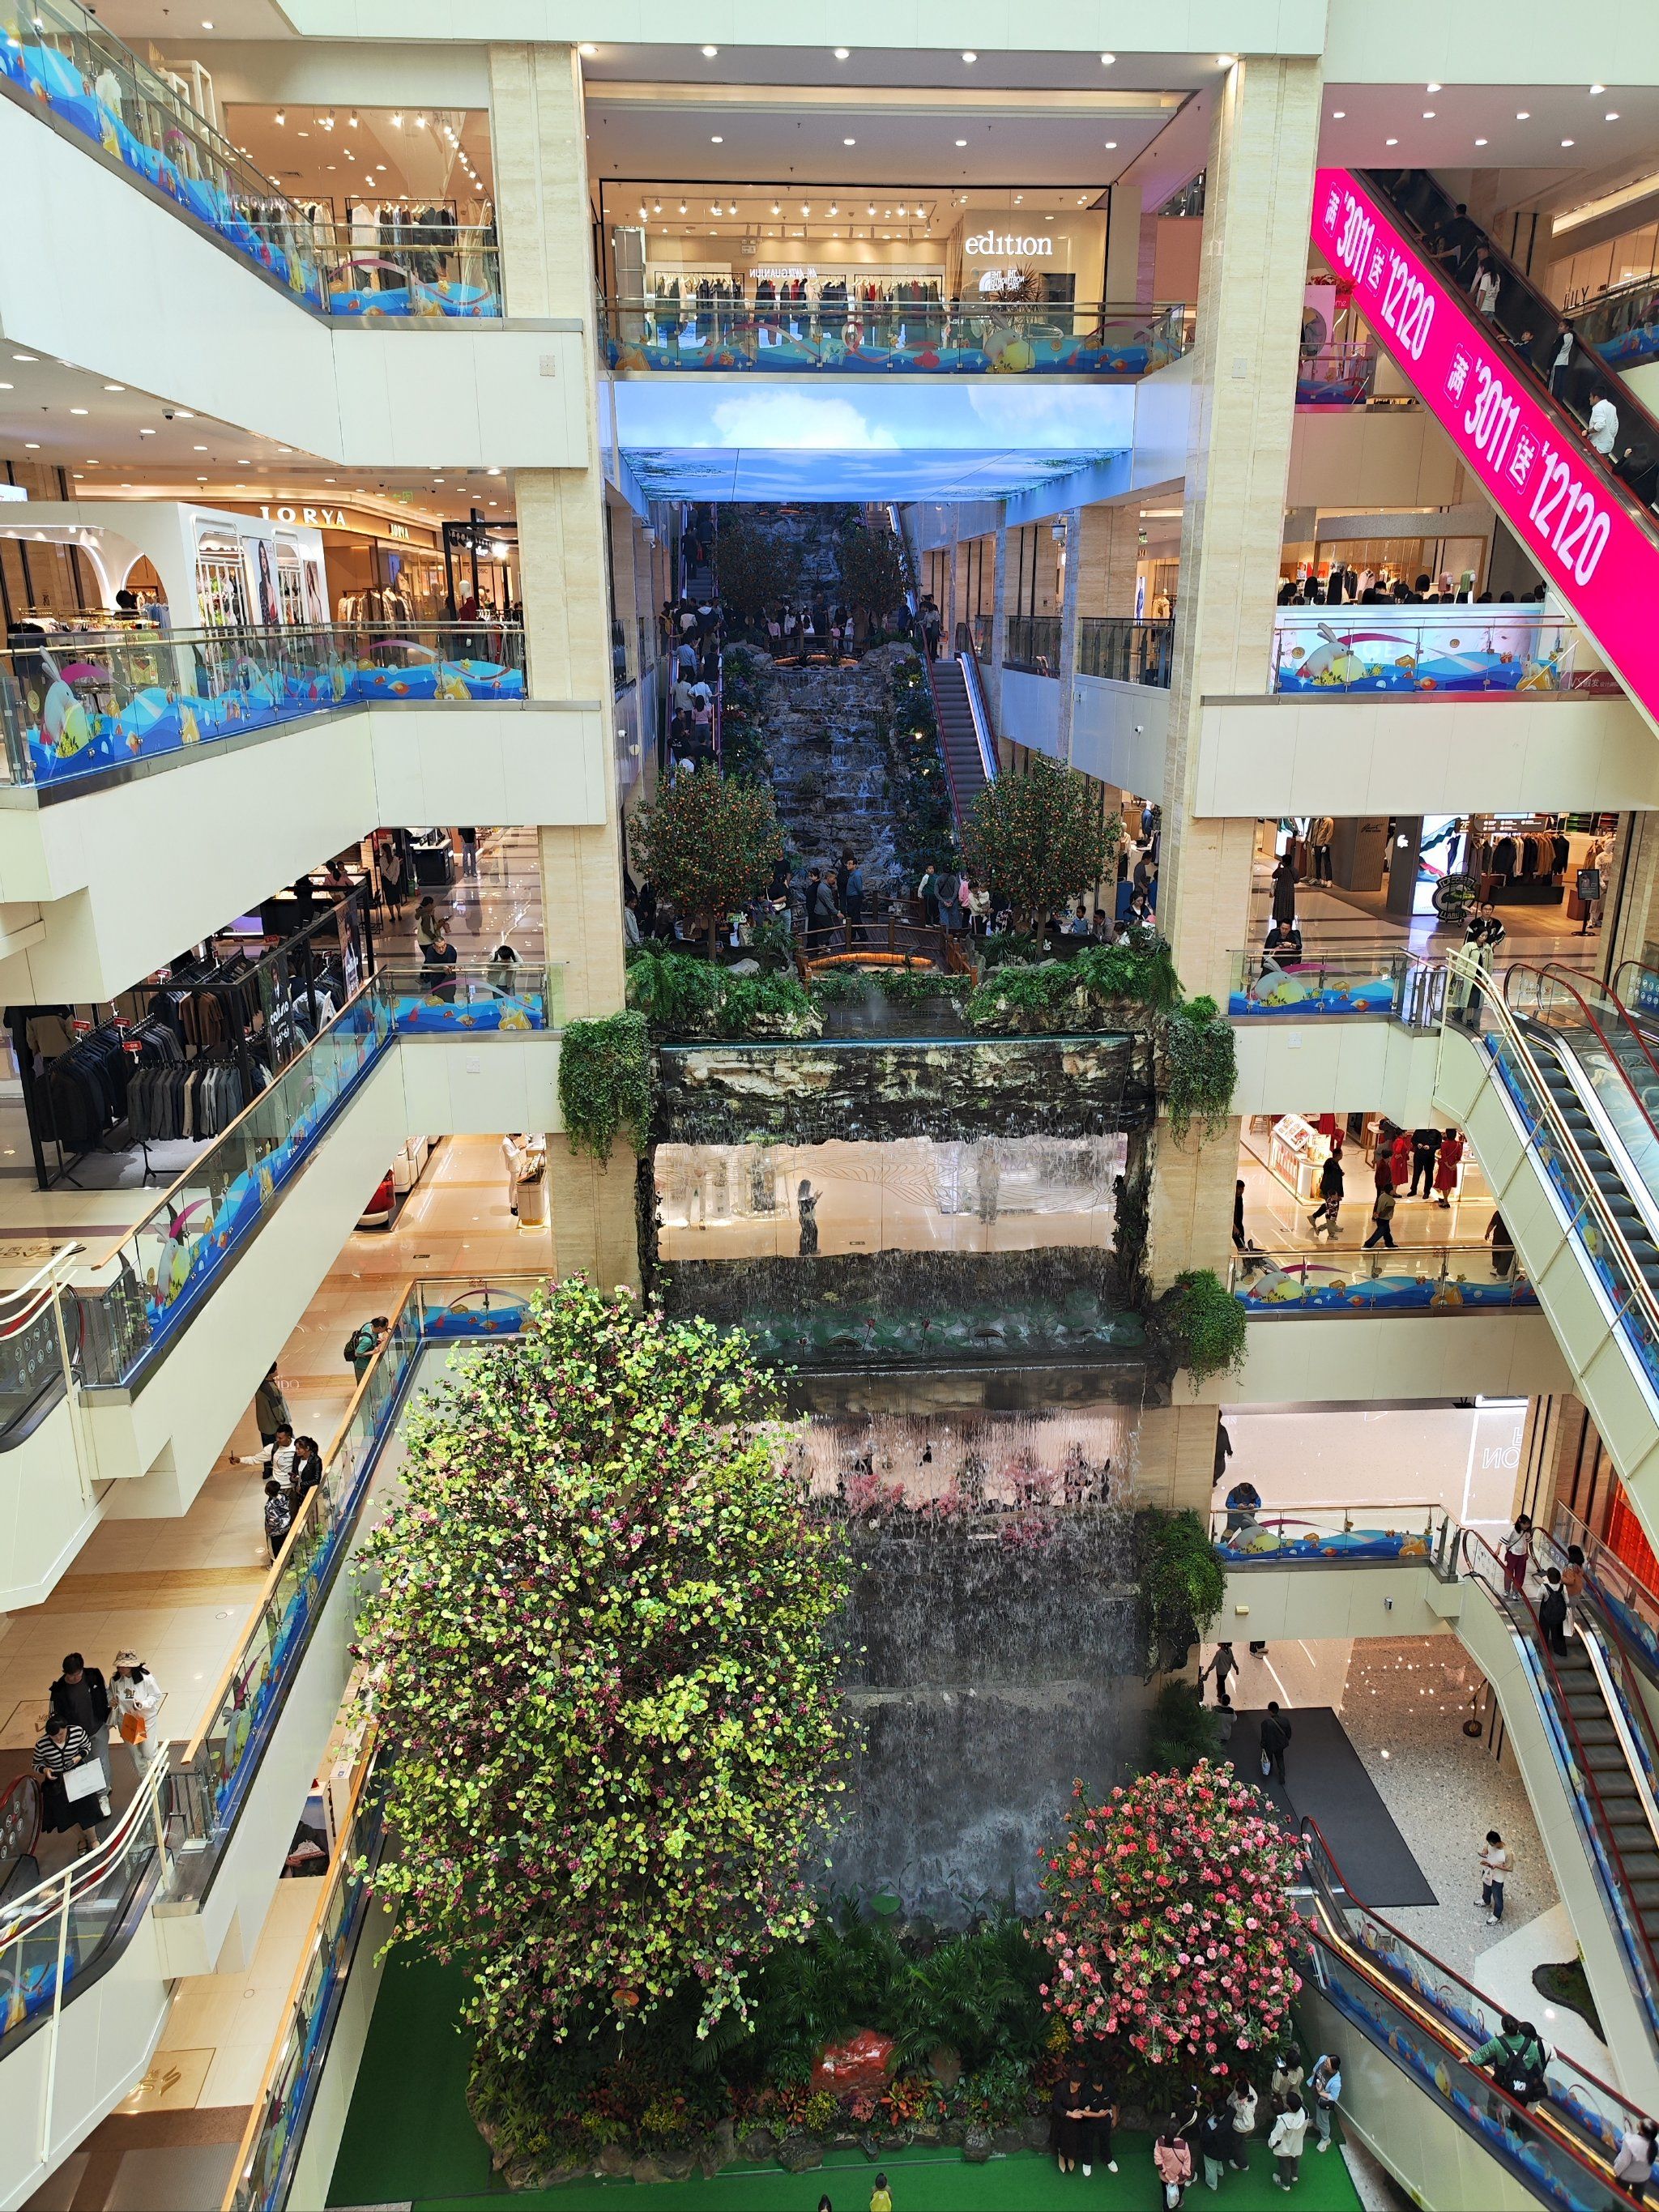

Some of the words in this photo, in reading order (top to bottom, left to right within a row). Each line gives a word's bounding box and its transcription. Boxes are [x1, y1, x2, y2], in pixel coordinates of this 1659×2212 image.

[965, 230, 1053, 256] edition
[1324, 190, 1340, 231] 满
[1367, 248, 1386, 290] 送
[1447, 352, 1469, 401] 满
[1509, 434, 1535, 486] 送
[389, 523, 410, 540] JORYA
[1460, 820, 1470, 829] 2F
